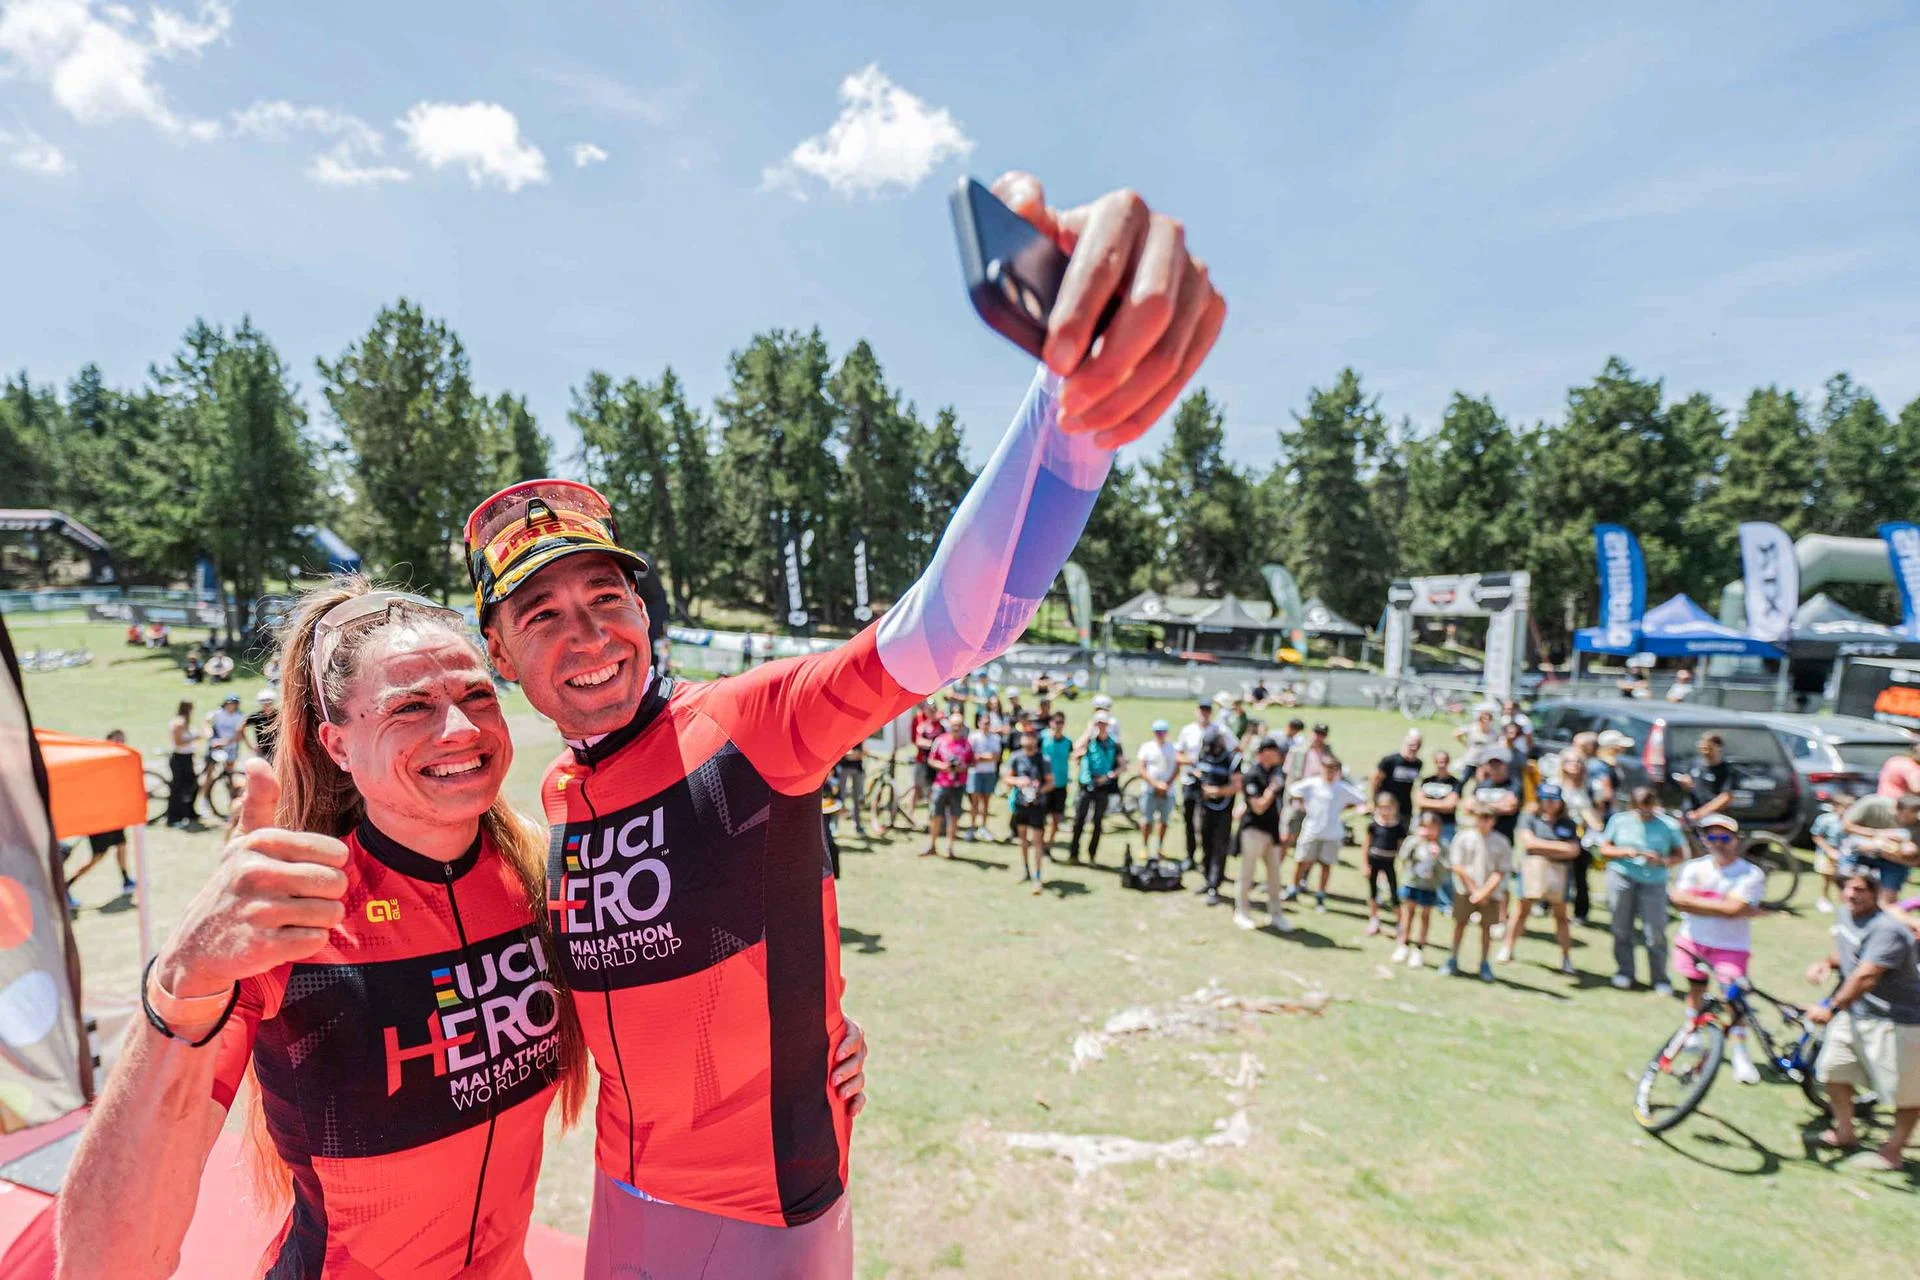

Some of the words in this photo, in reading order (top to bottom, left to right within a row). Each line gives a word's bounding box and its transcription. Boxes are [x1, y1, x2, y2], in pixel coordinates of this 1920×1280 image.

[580, 806, 664, 870] UCI
[546, 857, 672, 934] HERO
[455, 936, 548, 999] UCI
[569, 922, 674, 956] MARATHON
[571, 947, 637, 971] WORLD
[642, 938, 683, 960] CUP
[383, 980, 560, 1097] HERO
[452, 1065, 531, 1112] WORLD
